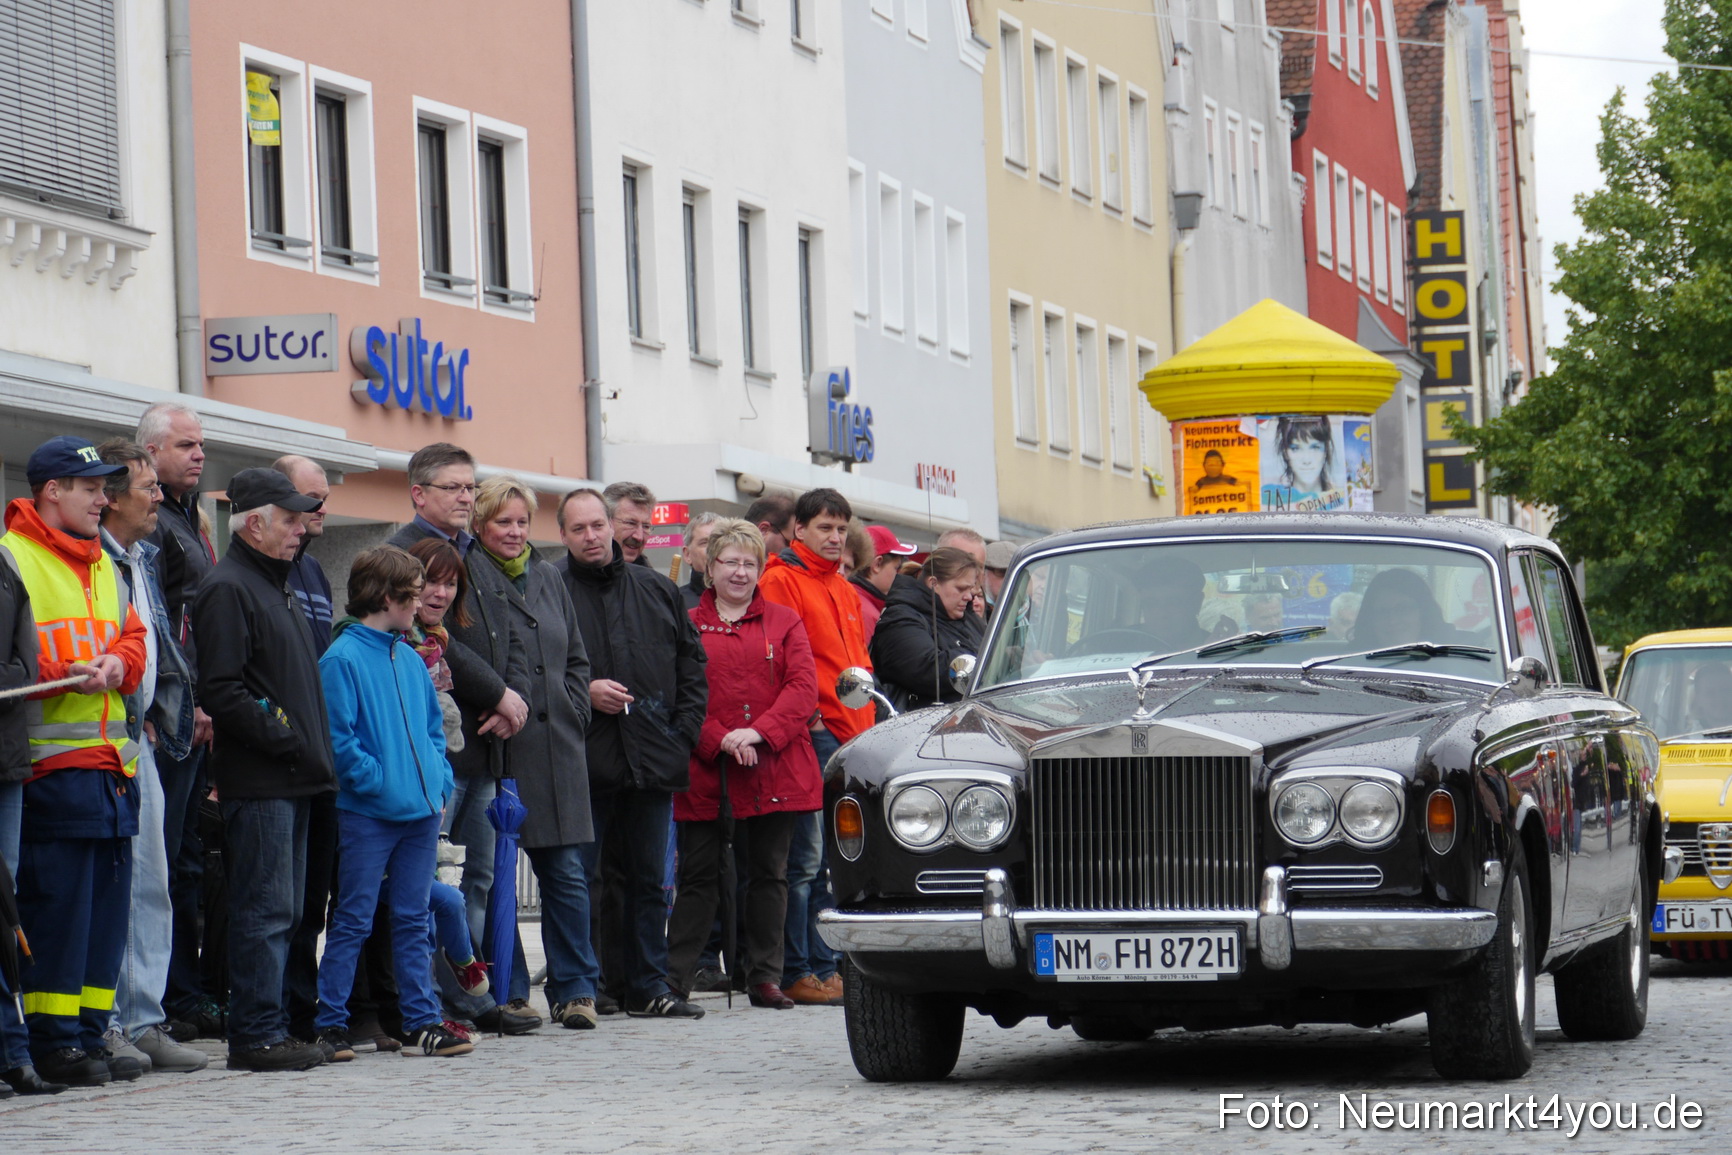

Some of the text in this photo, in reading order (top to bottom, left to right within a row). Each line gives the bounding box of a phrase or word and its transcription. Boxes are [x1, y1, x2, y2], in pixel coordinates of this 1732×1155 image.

[1415, 216, 1472, 502] HOTEL
[827, 366, 875, 463] fries
[1184, 424, 1240, 435] Neumarkt
[1185, 437, 1254, 449] Flohmarkt
[1193, 492, 1246, 506] Samstag
[1298, 498, 1327, 512] OPEN
[1328, 491, 1341, 509] AIR
[655, 505, 669, 523] T
[1055, 937, 1235, 969] NM FH 872H
[1041, 958, 1049, 968] D
